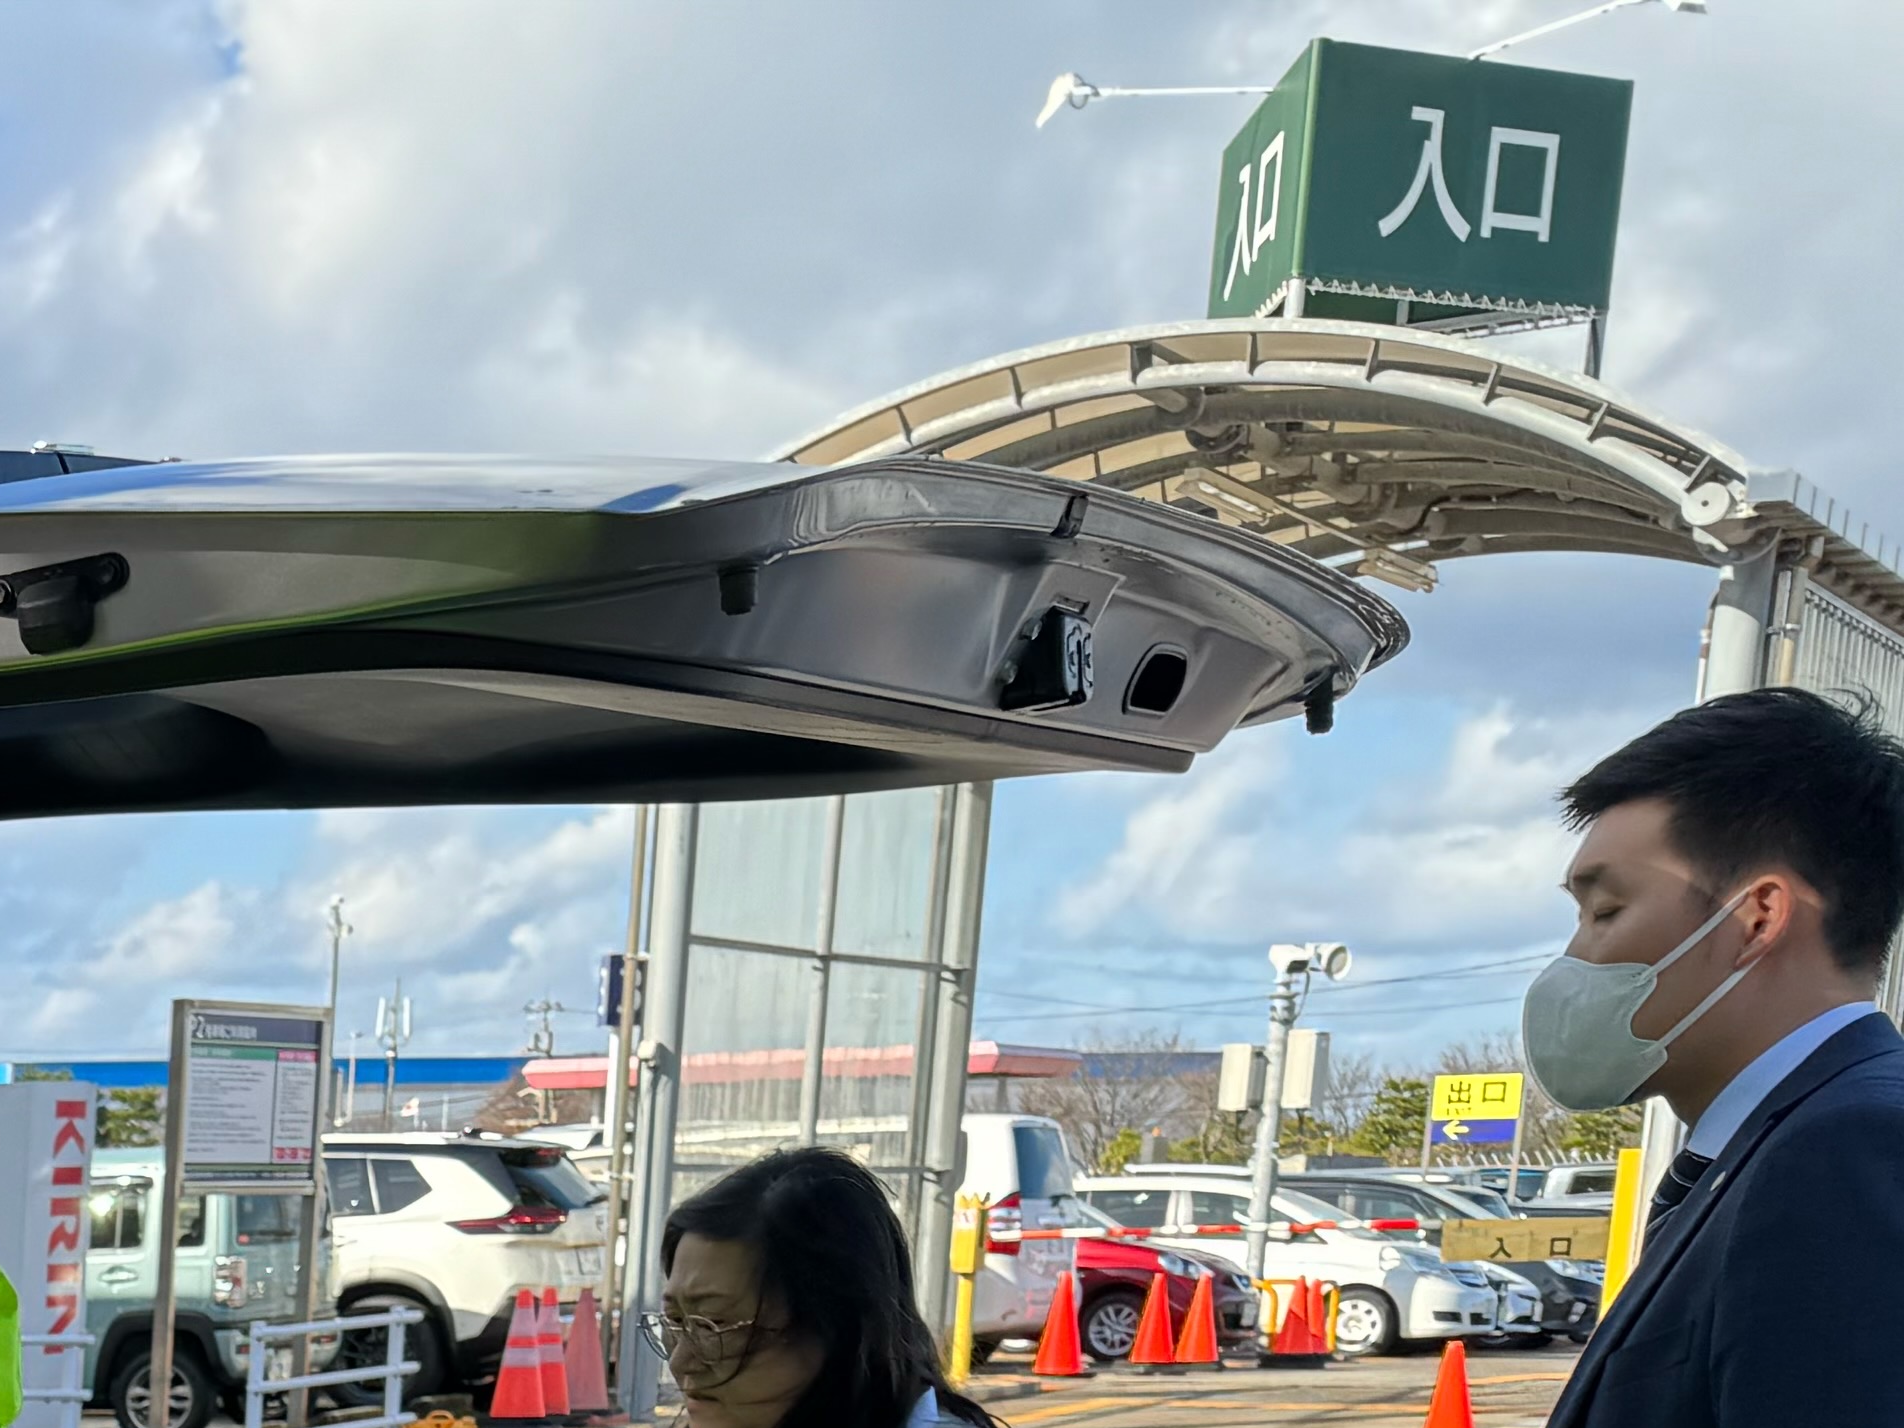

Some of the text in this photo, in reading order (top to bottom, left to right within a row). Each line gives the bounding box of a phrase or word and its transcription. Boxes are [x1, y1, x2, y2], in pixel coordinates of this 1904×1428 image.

[1223, 130, 1285, 302] 入口
[1378, 105, 1561, 243] 入口
[1447, 1081, 1507, 1104] 出口
[43, 1099, 87, 1356] KIRIN
[1490, 1237, 1573, 1259] 入口
